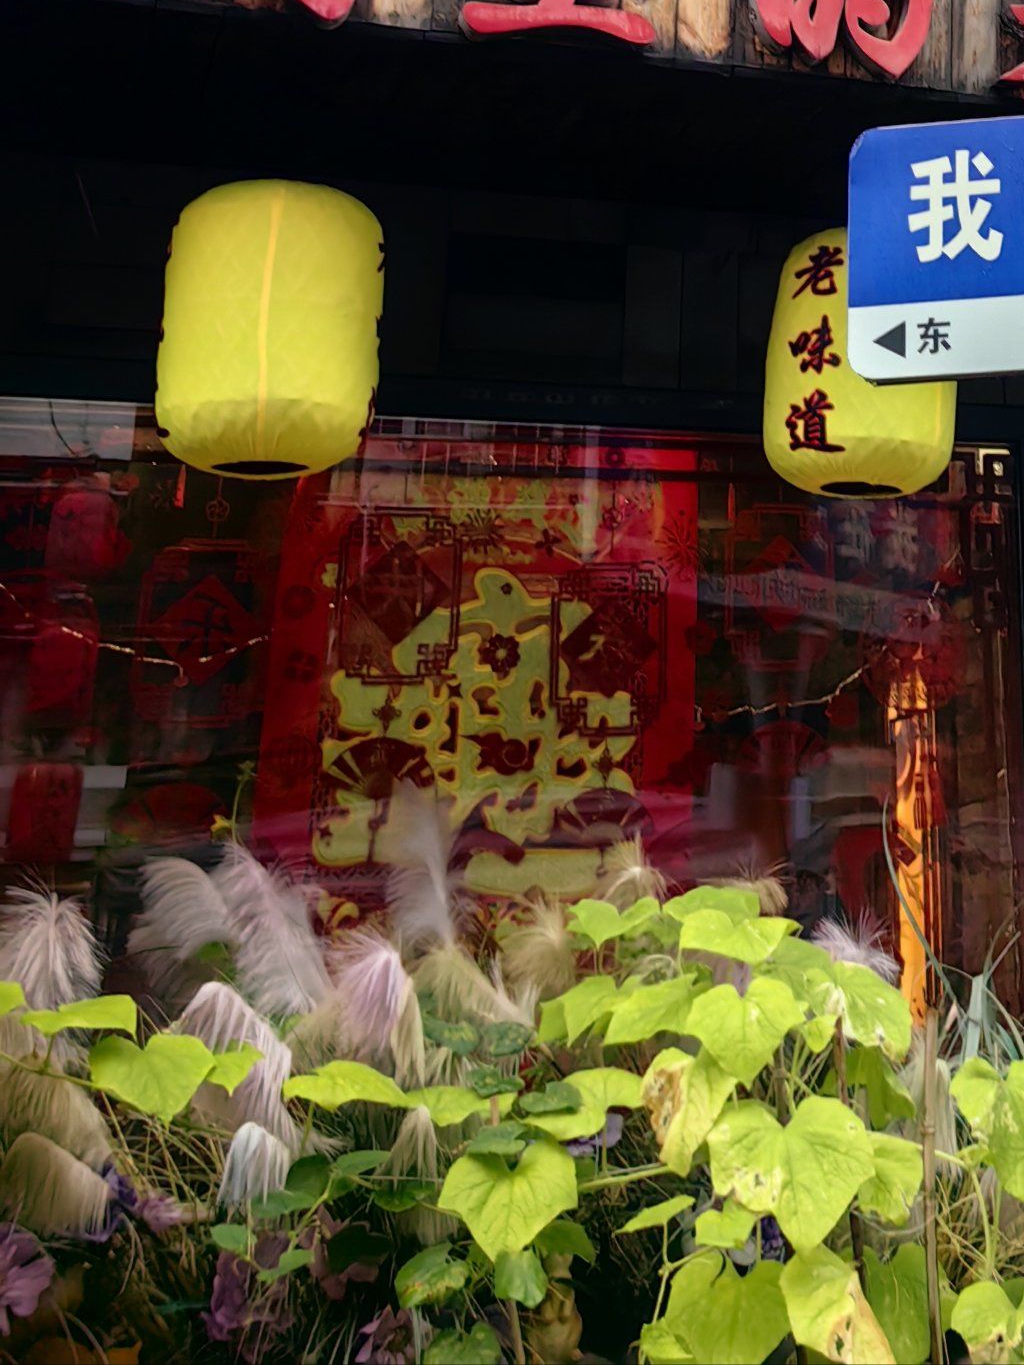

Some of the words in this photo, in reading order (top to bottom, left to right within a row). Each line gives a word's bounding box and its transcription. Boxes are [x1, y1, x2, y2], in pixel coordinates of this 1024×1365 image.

[785, 245, 846, 454] 老味道
[916, 317, 952, 355] 东
